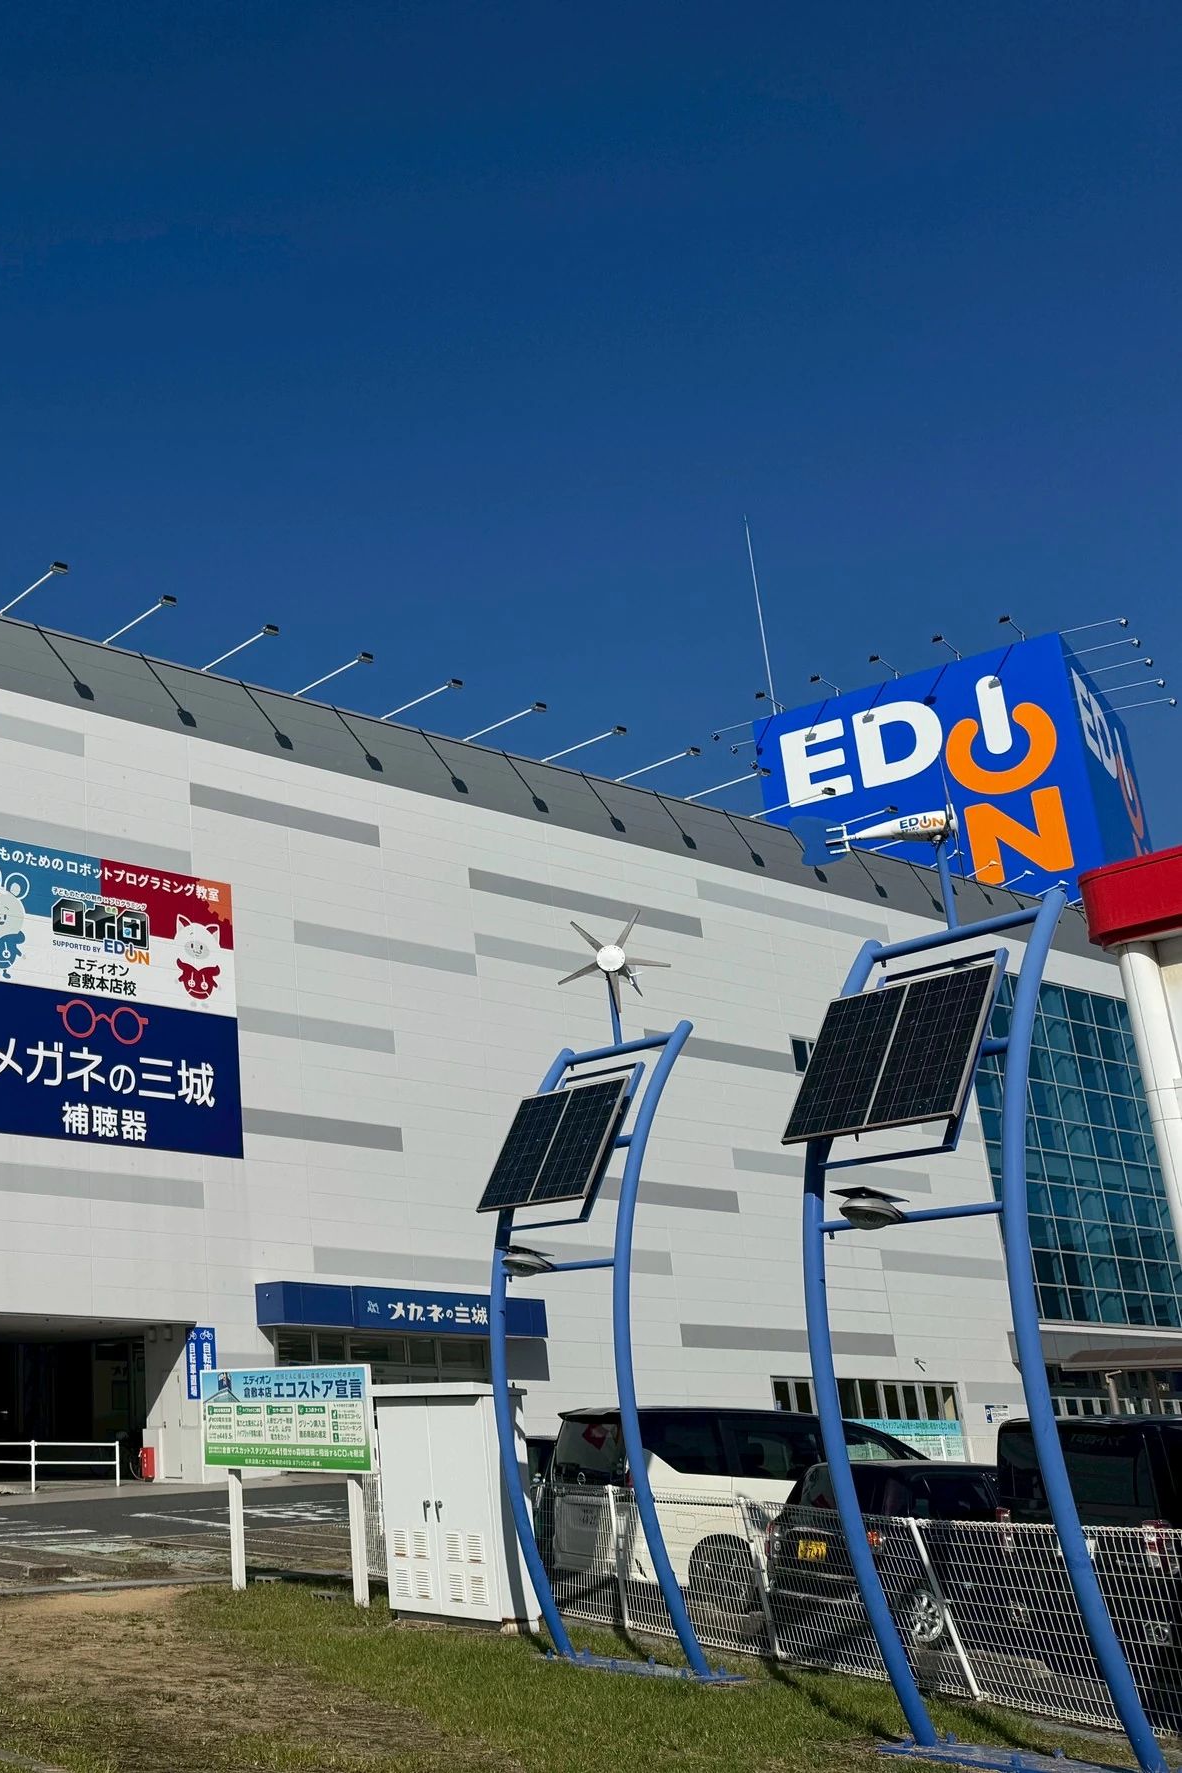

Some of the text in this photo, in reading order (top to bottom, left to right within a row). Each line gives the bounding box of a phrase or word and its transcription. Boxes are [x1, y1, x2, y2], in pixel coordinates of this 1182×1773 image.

[779, 675, 1074, 885] EDION
[899, 816, 944, 829] EDION
[52, 940, 91, 951] SUPPORTED
[104, 940, 150, 965] EDION
[75, 958, 129, 976] エディオン
[68, 972, 136, 996] 倉敷本店校
[62, 1102, 147, 1141] 補聴器
[388, 1302, 489, 1325] メガネの三城
[243, 1376, 272, 1385] エディオン
[274, 1378, 362, 1399] エコストア宣言
[243, 1387, 272, 1398] 倉敷本店
